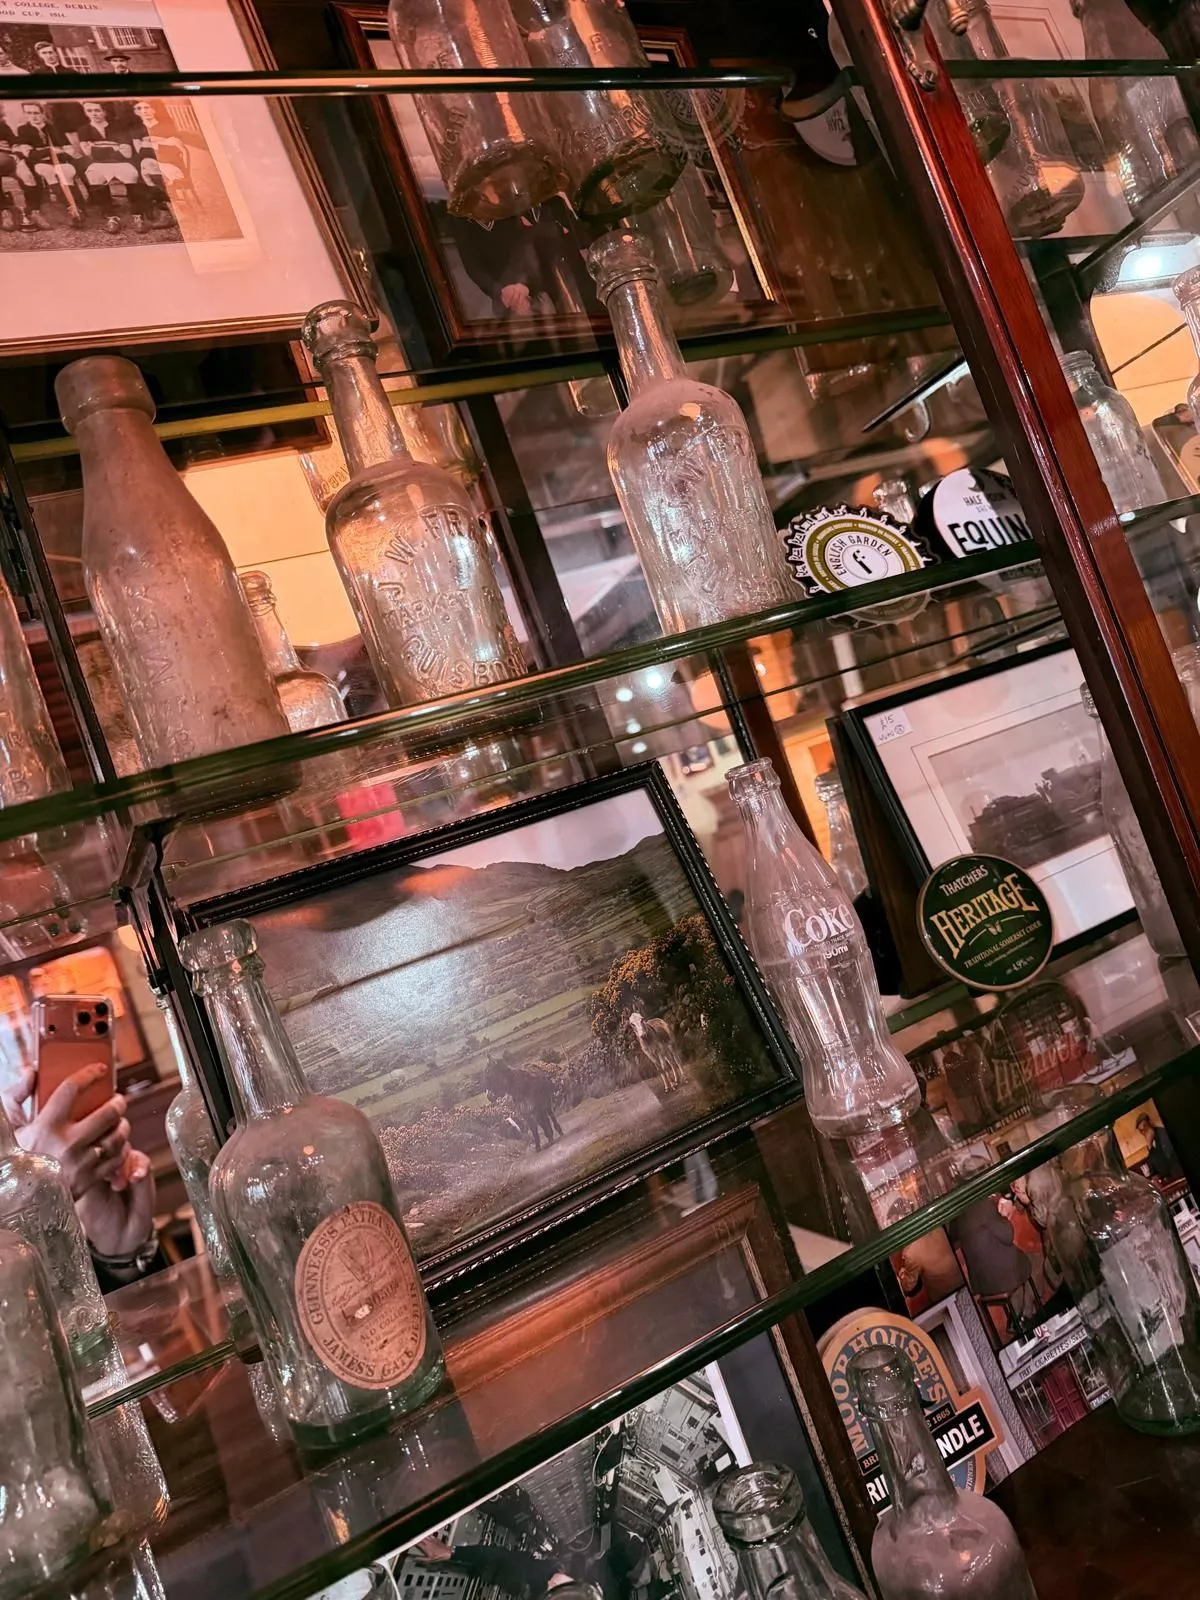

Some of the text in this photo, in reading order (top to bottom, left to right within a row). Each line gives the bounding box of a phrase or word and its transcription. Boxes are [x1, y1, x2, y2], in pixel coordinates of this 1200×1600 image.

[947, 513, 1033, 556] EQUIN
[829, 535, 893, 577] ENGLISH GARDEN
[939, 864, 989, 897] THATCHERS
[929, 872, 1041, 960] HERITAGE
[963, 944, 1000, 969] TRADITIONAL
[999, 928, 1027, 948] SOMERSET
[341, 1209, 384, 1230] EXTRA
[1034, 1340, 1070, 1368] CIGARETTES
[932, 1408, 951, 1425] 1865
[936, 1415, 985, 1459] NDLE
